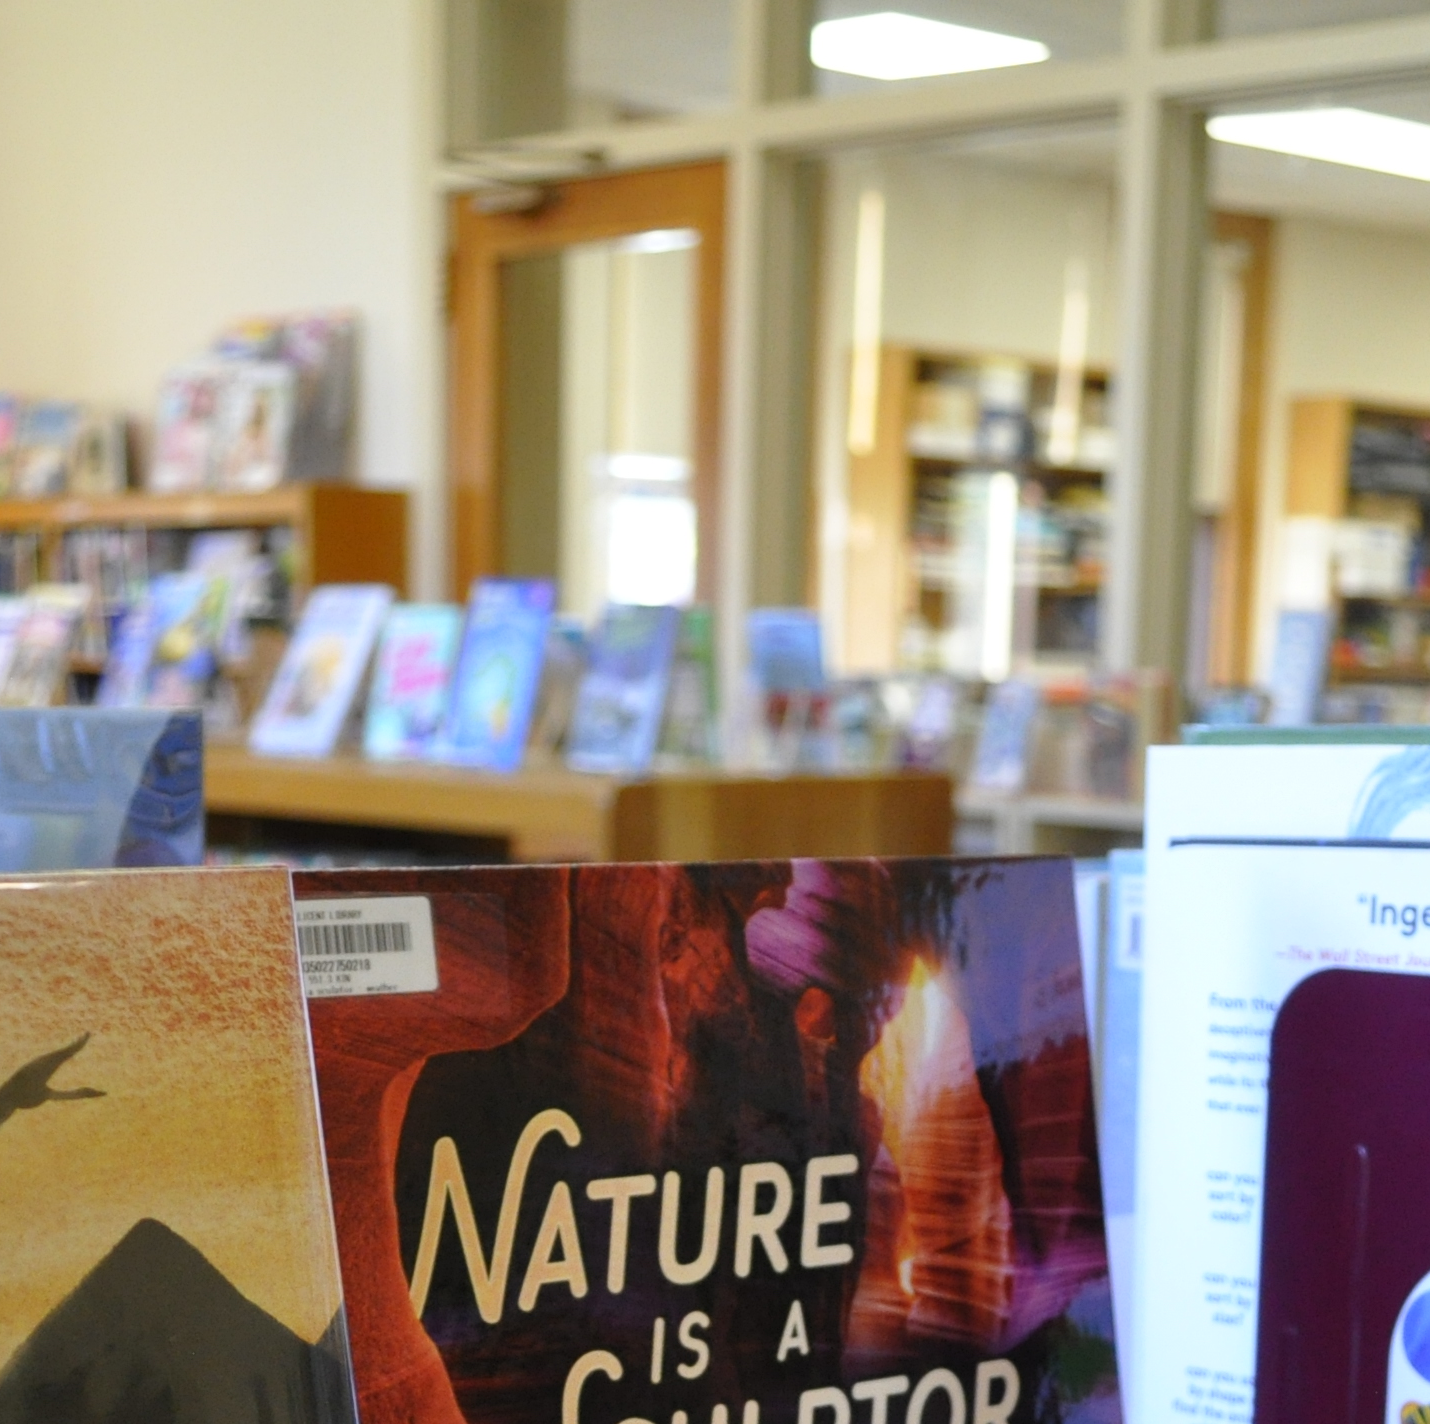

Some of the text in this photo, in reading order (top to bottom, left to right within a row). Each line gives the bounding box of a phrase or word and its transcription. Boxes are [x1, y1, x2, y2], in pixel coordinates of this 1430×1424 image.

[1318, 947, 1351, 966] Wall
[1354, 948, 1401, 968] Street
[407, 1108, 859, 1325] NATURE
[650, 1299, 810, 1385] IS A
